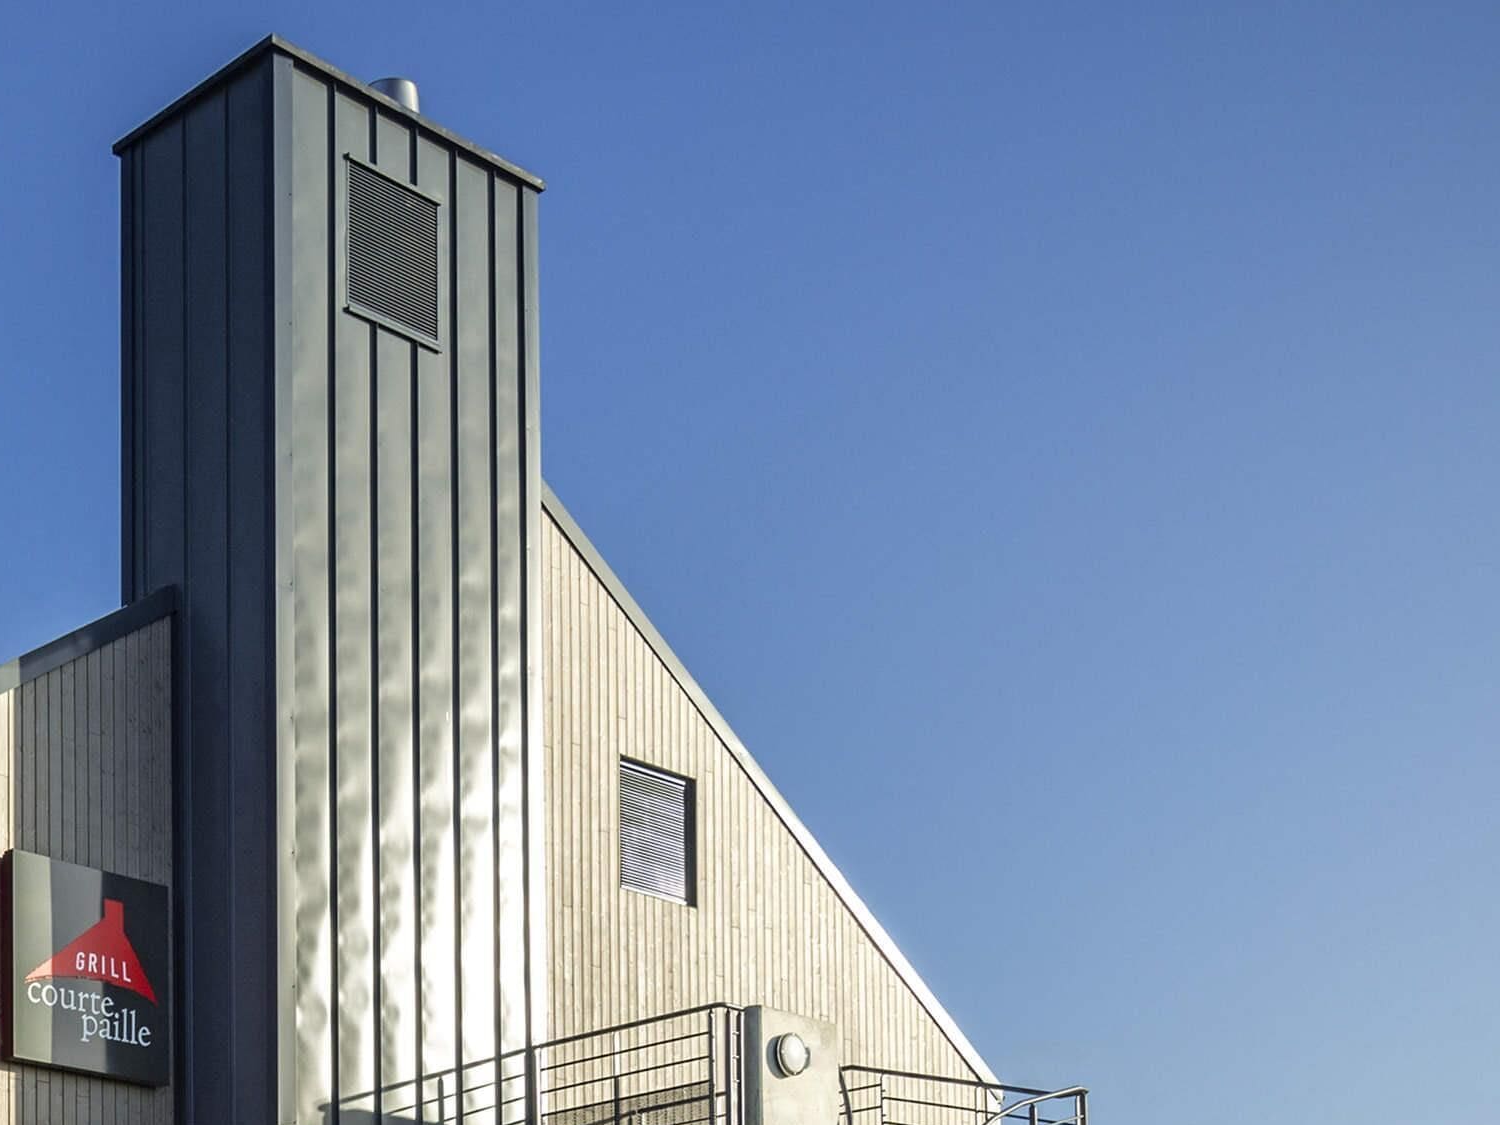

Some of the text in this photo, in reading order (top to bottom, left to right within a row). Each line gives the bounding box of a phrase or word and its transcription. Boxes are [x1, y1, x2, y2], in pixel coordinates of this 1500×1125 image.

[75, 951, 132, 983] GRILL
[27, 981, 115, 1018] courte
[80, 1008, 152, 1047] paille
